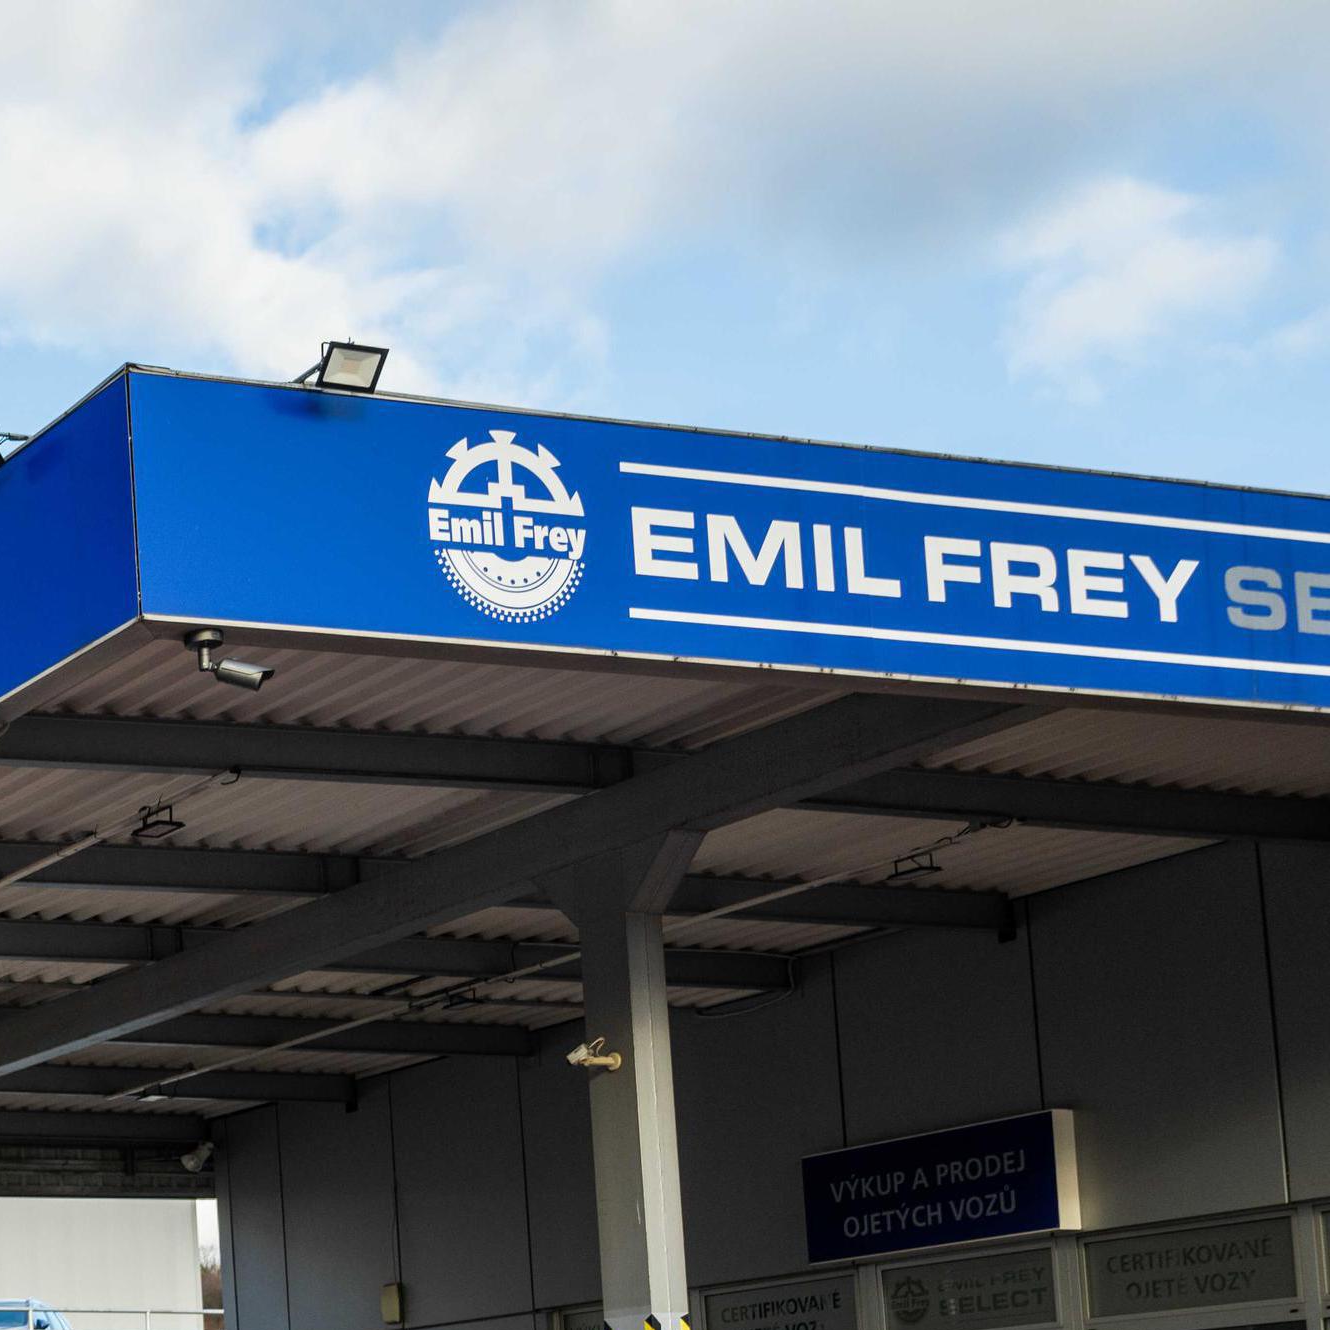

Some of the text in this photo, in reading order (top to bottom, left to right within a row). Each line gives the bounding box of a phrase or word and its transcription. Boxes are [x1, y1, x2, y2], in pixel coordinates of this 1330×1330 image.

[428, 508, 587, 561] Emil Frey
[630, 506, 902, 599] EMIL
[924, 534, 1200, 624] FREY
[829, 1149, 1026, 1204] VÝKUP A PRODEJ
[843, 1184, 1017, 1239] OJETÝCH VOZŮ
[1107, 1234, 1274, 1274] CERTIFIKOVANÉ
[1126, 1270, 1257, 1299] OJETÉ VOZY
